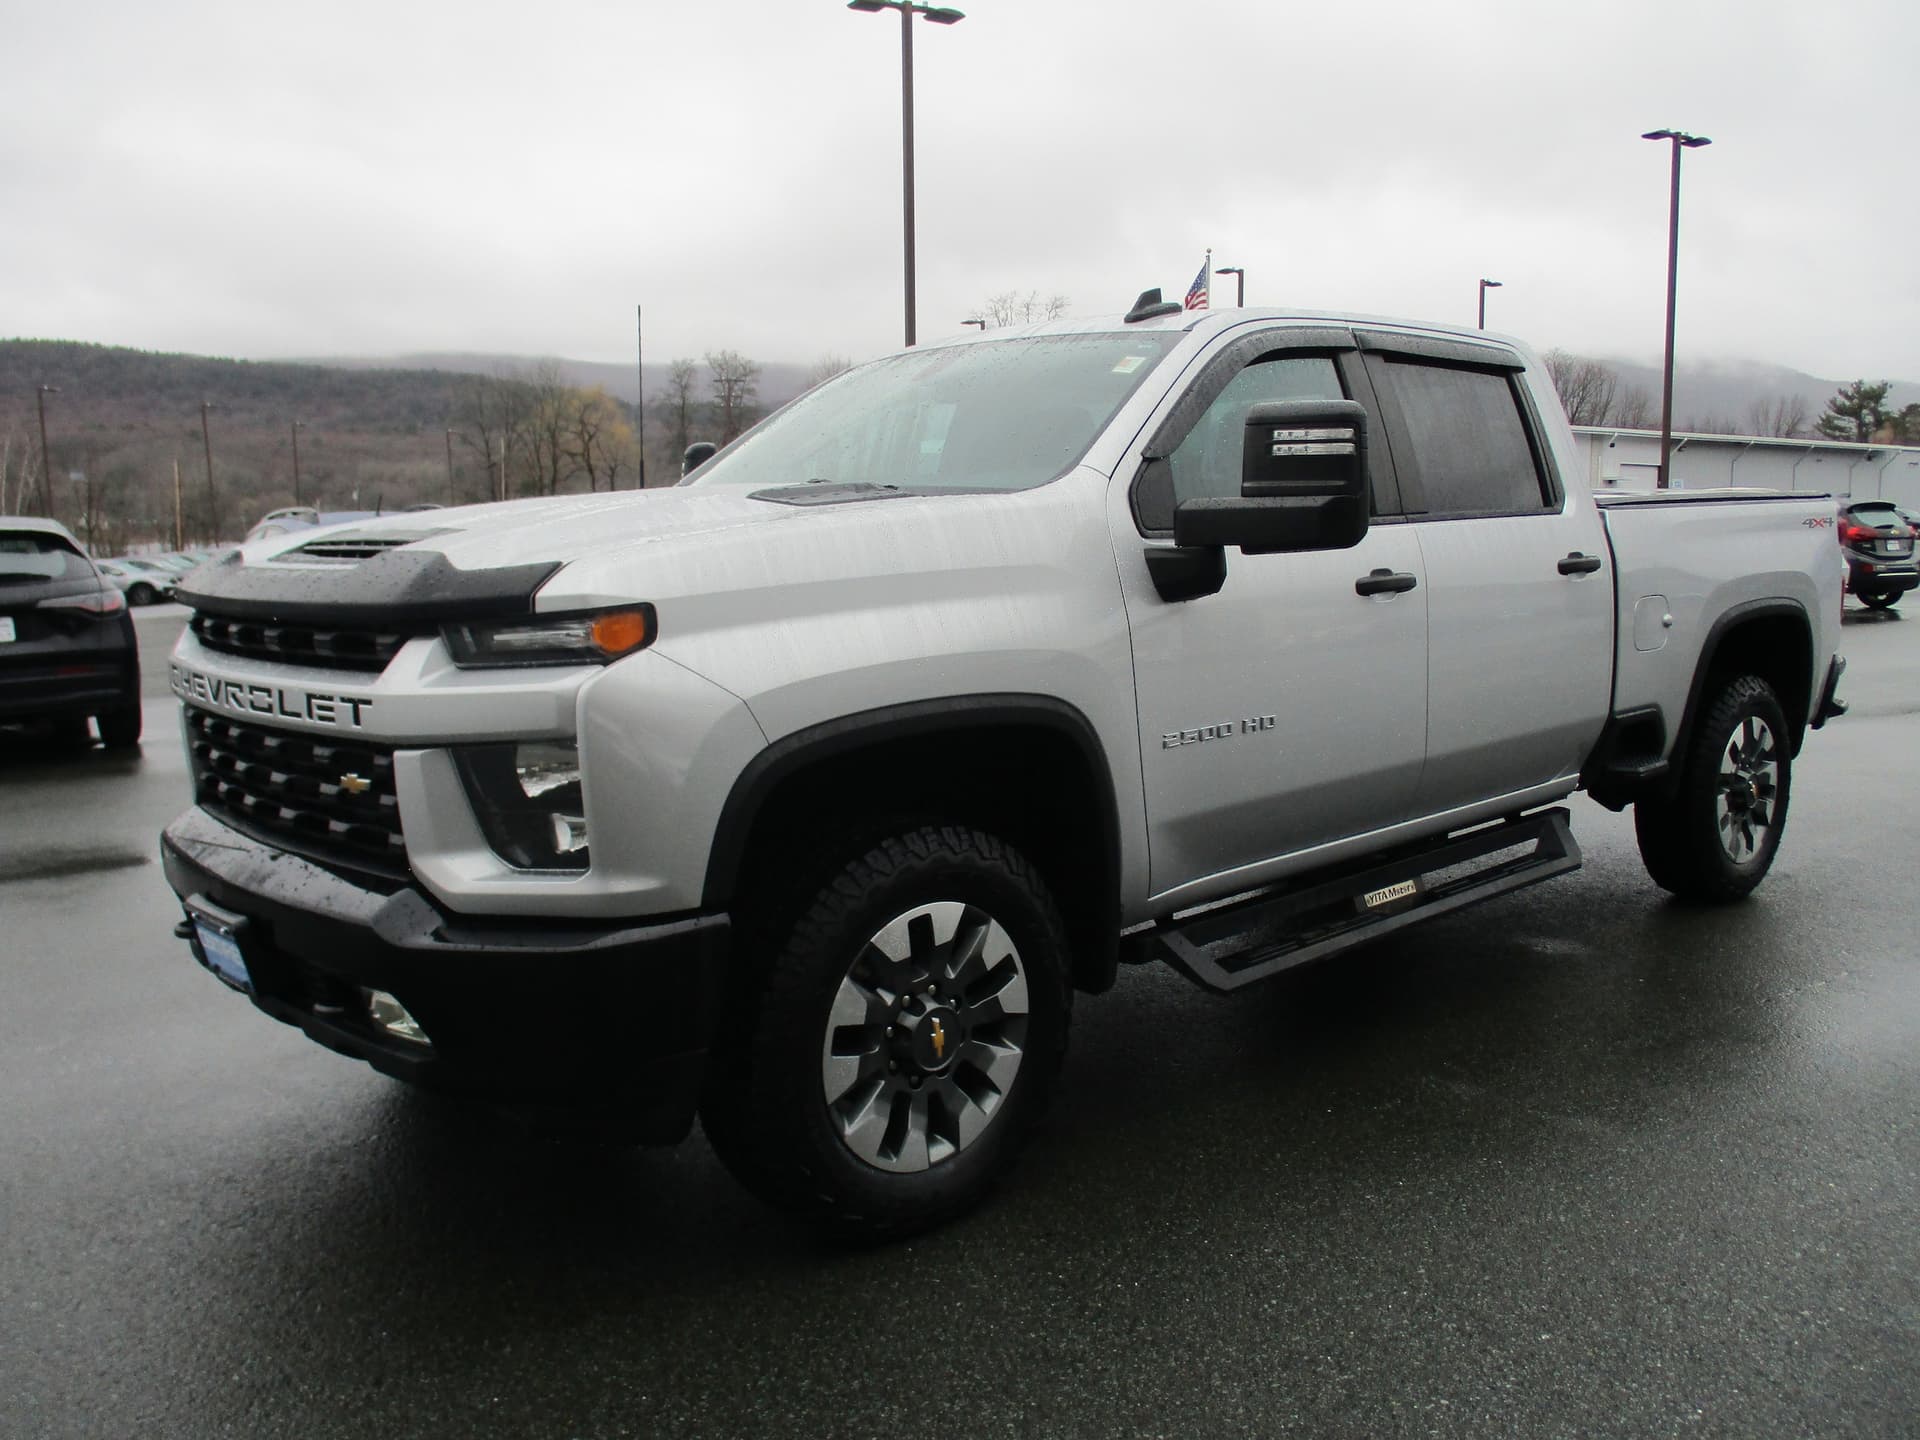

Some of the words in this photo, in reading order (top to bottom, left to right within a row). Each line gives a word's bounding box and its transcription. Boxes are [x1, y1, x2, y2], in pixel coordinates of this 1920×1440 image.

[170, 664, 374, 728] CHEVROLET
[1162, 722, 1234, 750] 2500
[1241, 714, 1277, 734] HD
